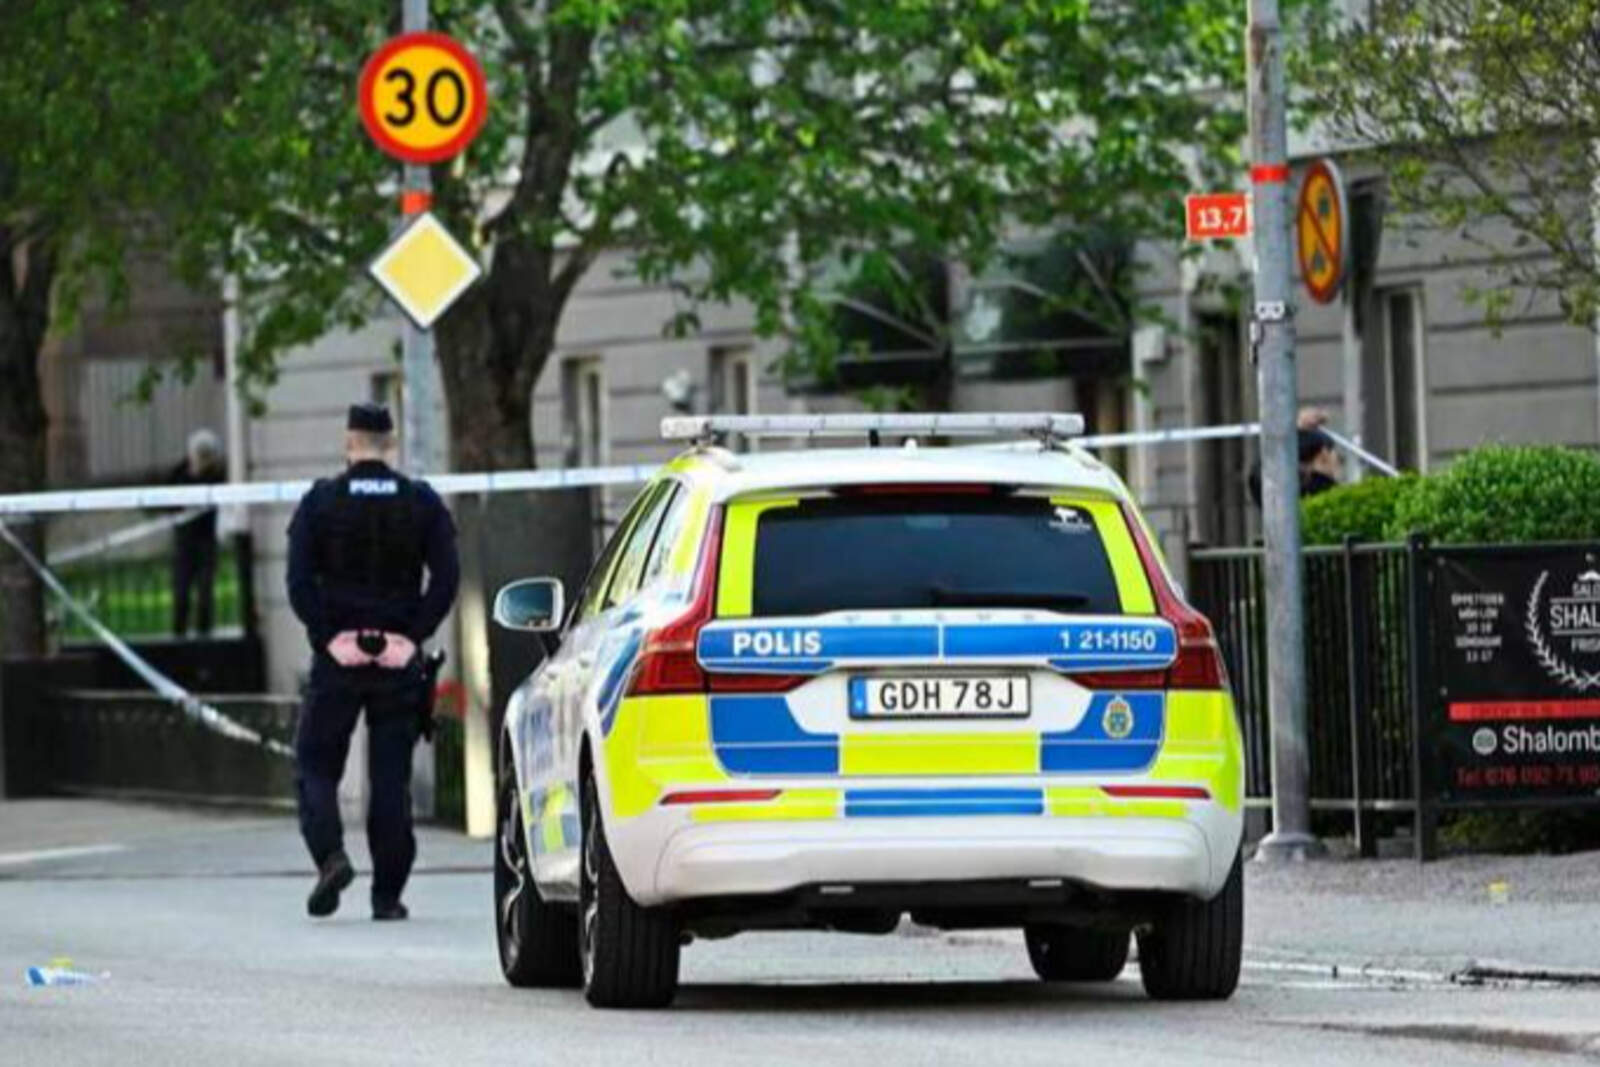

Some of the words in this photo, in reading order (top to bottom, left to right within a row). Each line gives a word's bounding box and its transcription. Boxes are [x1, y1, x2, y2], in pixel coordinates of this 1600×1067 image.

[385, 66, 466, 127] 30
[1198, 206, 1243, 230] 13,7
[350, 478, 397, 495] POLIS
[1550, 604, 1600, 629] SHAL
[733, 631, 821, 655] POLIS
[1060, 631, 1070, 649] 1
[1080, 629, 1157, 650] 21-1150
[879, 681, 941, 710] GDH
[952, 681, 1014, 709] 78J
[1503, 725, 1600, 753] Shalomb
